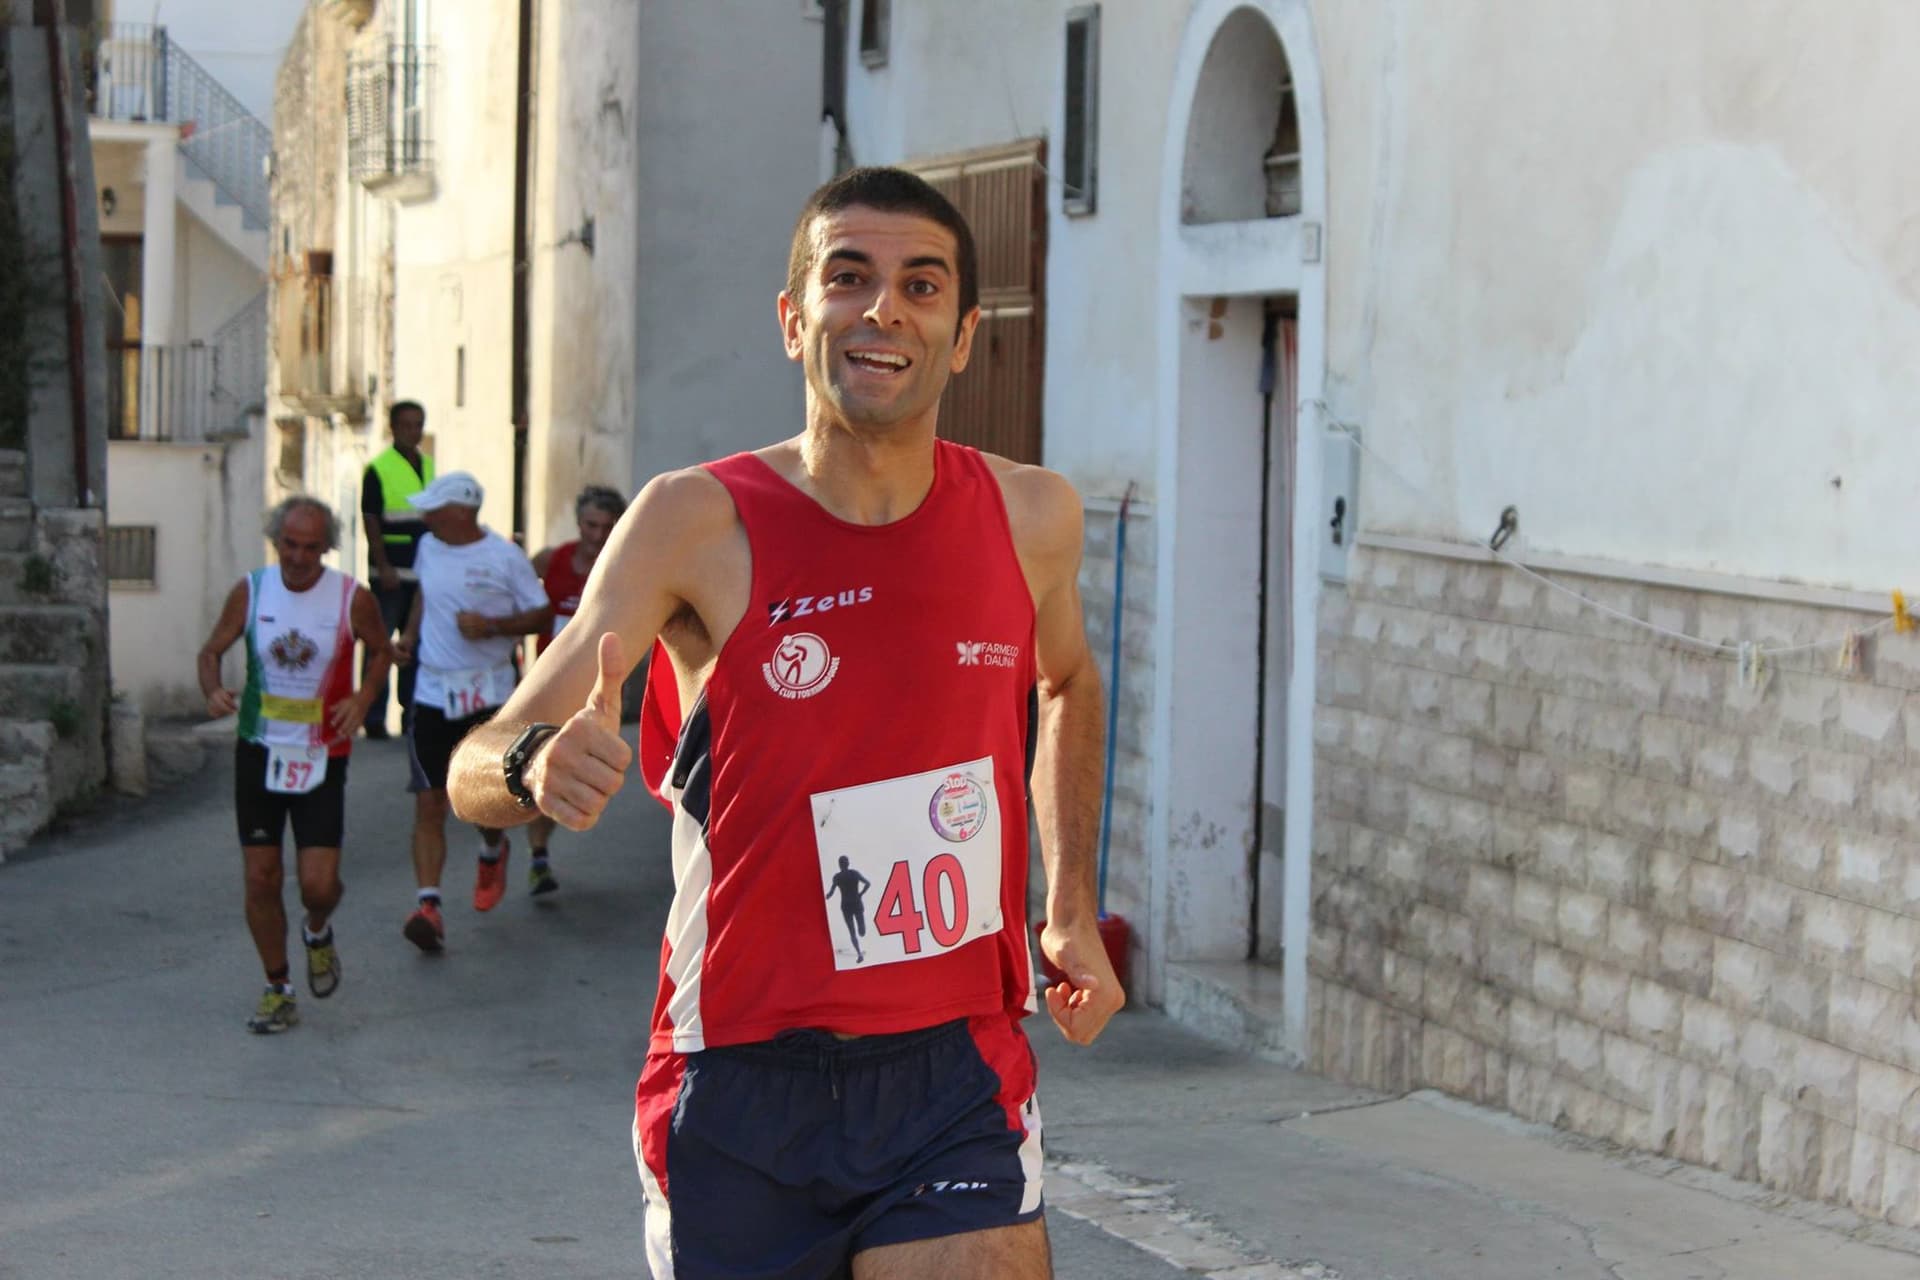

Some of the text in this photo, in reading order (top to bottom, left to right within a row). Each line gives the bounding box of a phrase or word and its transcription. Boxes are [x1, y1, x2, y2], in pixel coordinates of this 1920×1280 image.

[791, 586, 873, 618] Zeus
[459, 688, 486, 714] 16
[284, 760, 313, 790] 57
[873, 852, 970, 955] 40
